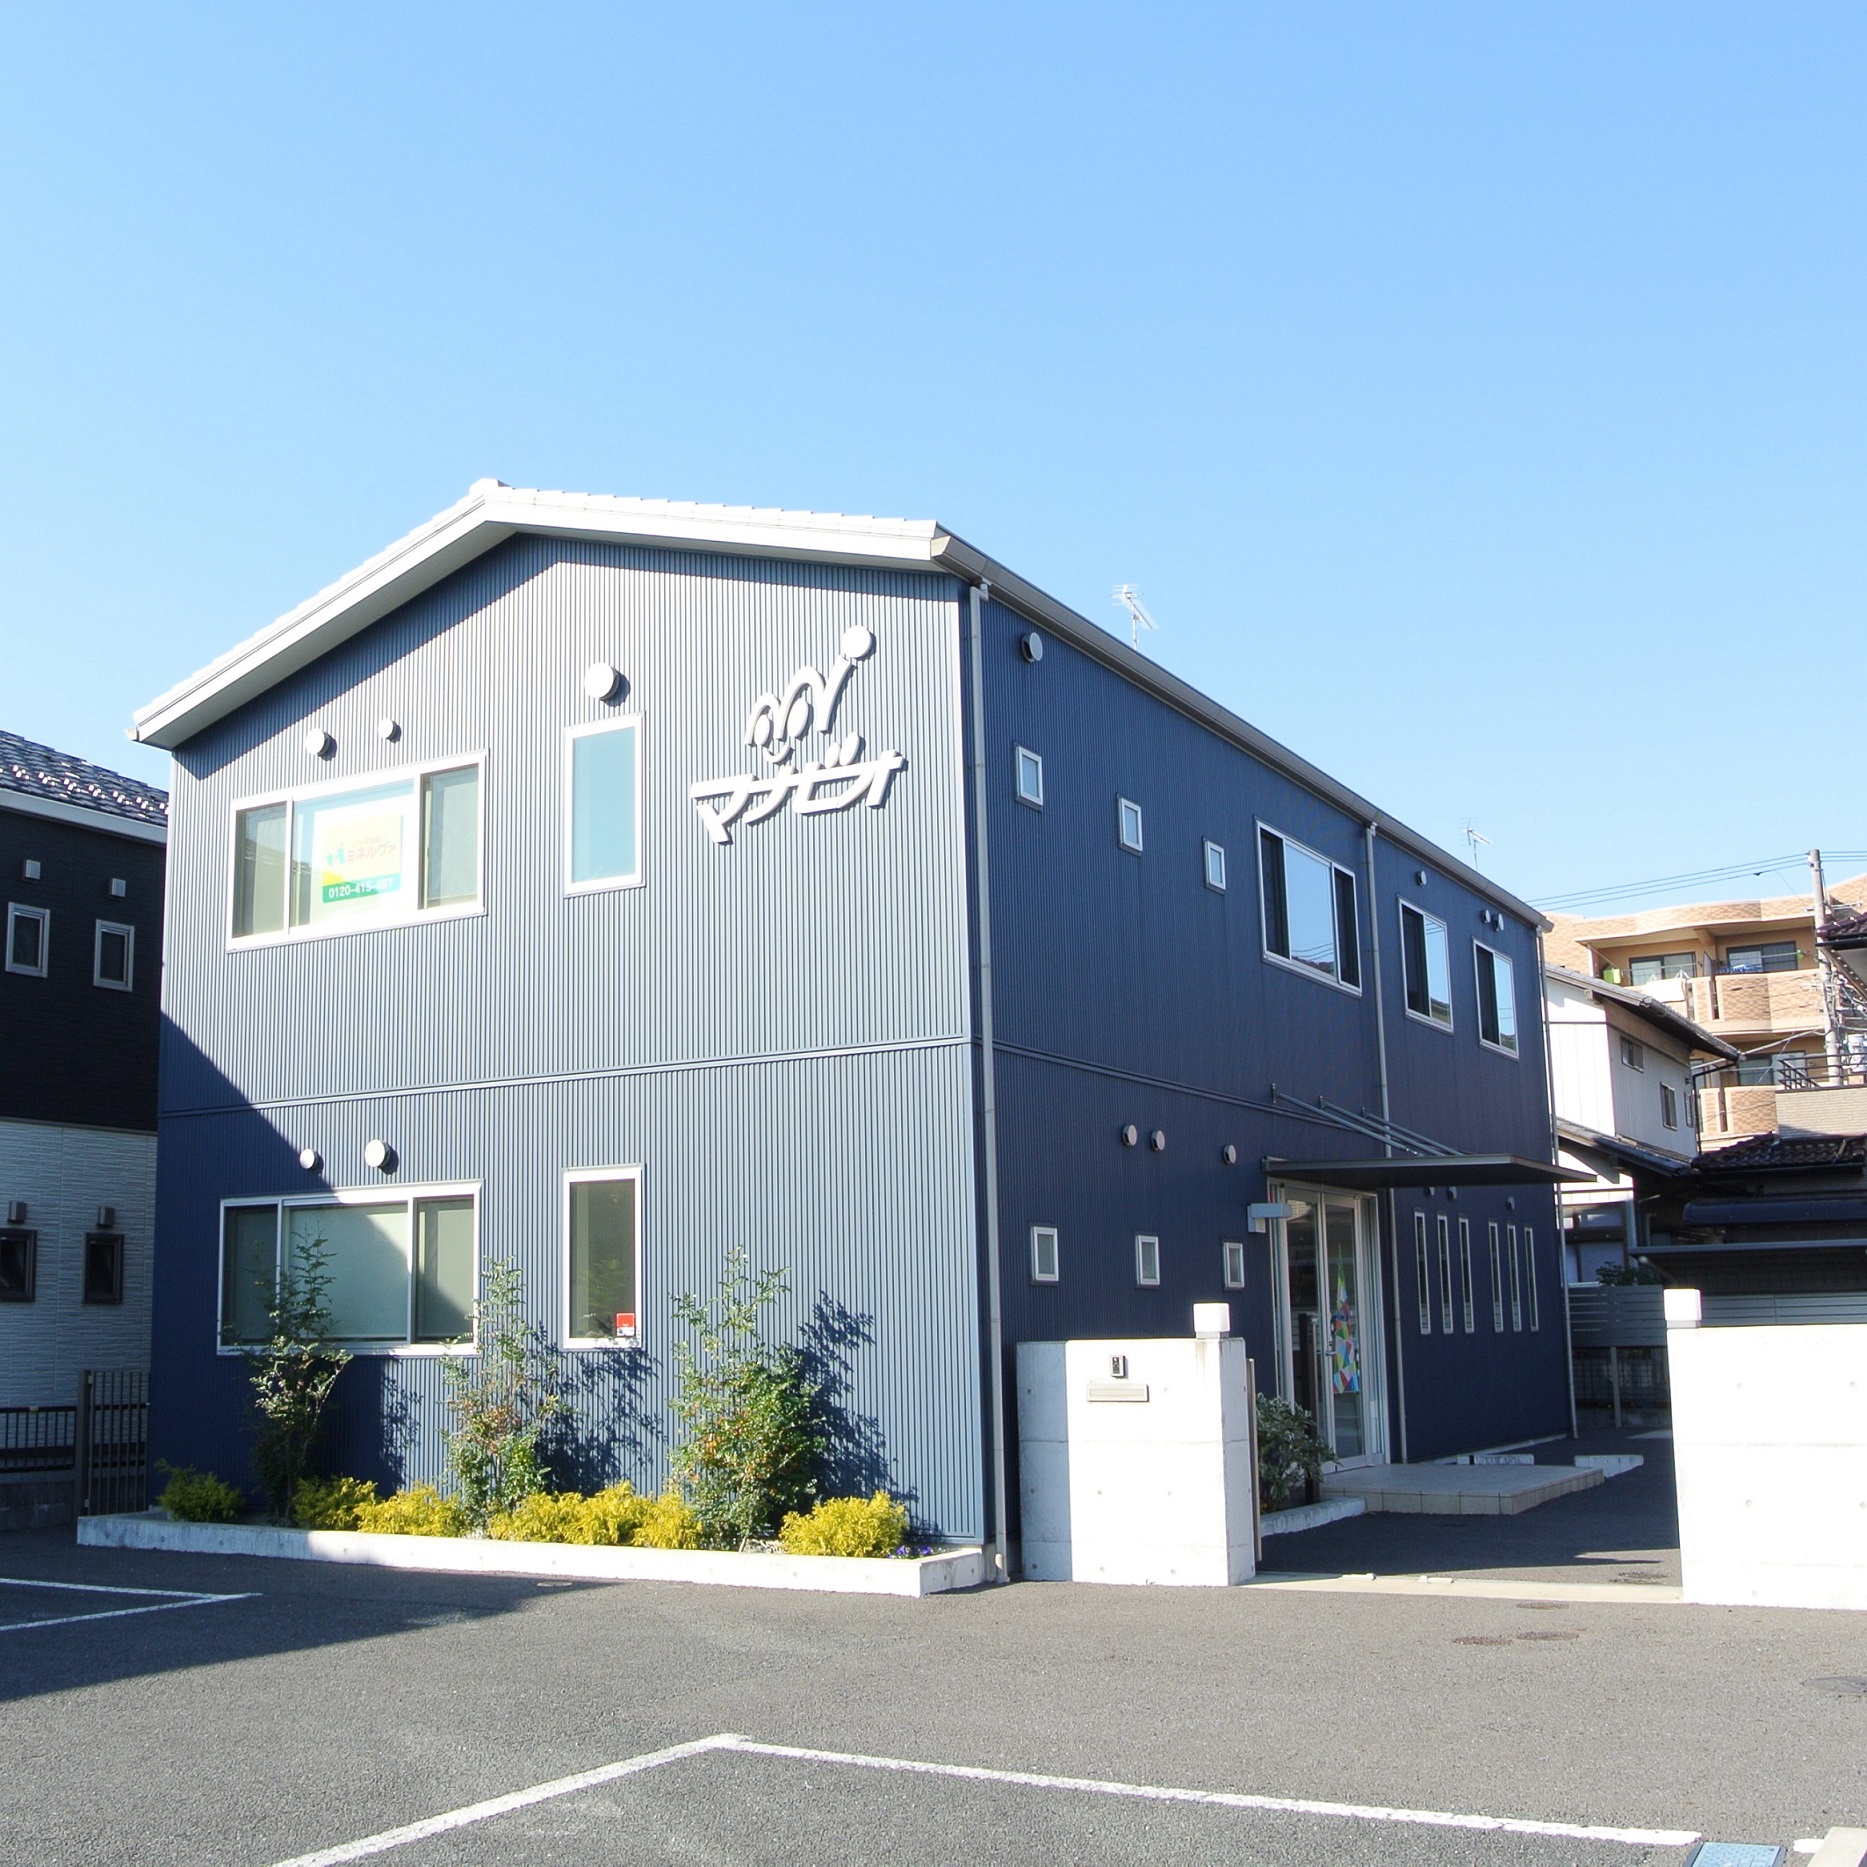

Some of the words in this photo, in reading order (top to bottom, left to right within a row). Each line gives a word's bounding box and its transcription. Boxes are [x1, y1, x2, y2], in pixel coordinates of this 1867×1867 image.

[346, 841, 397, 862] ミネルヴァ
